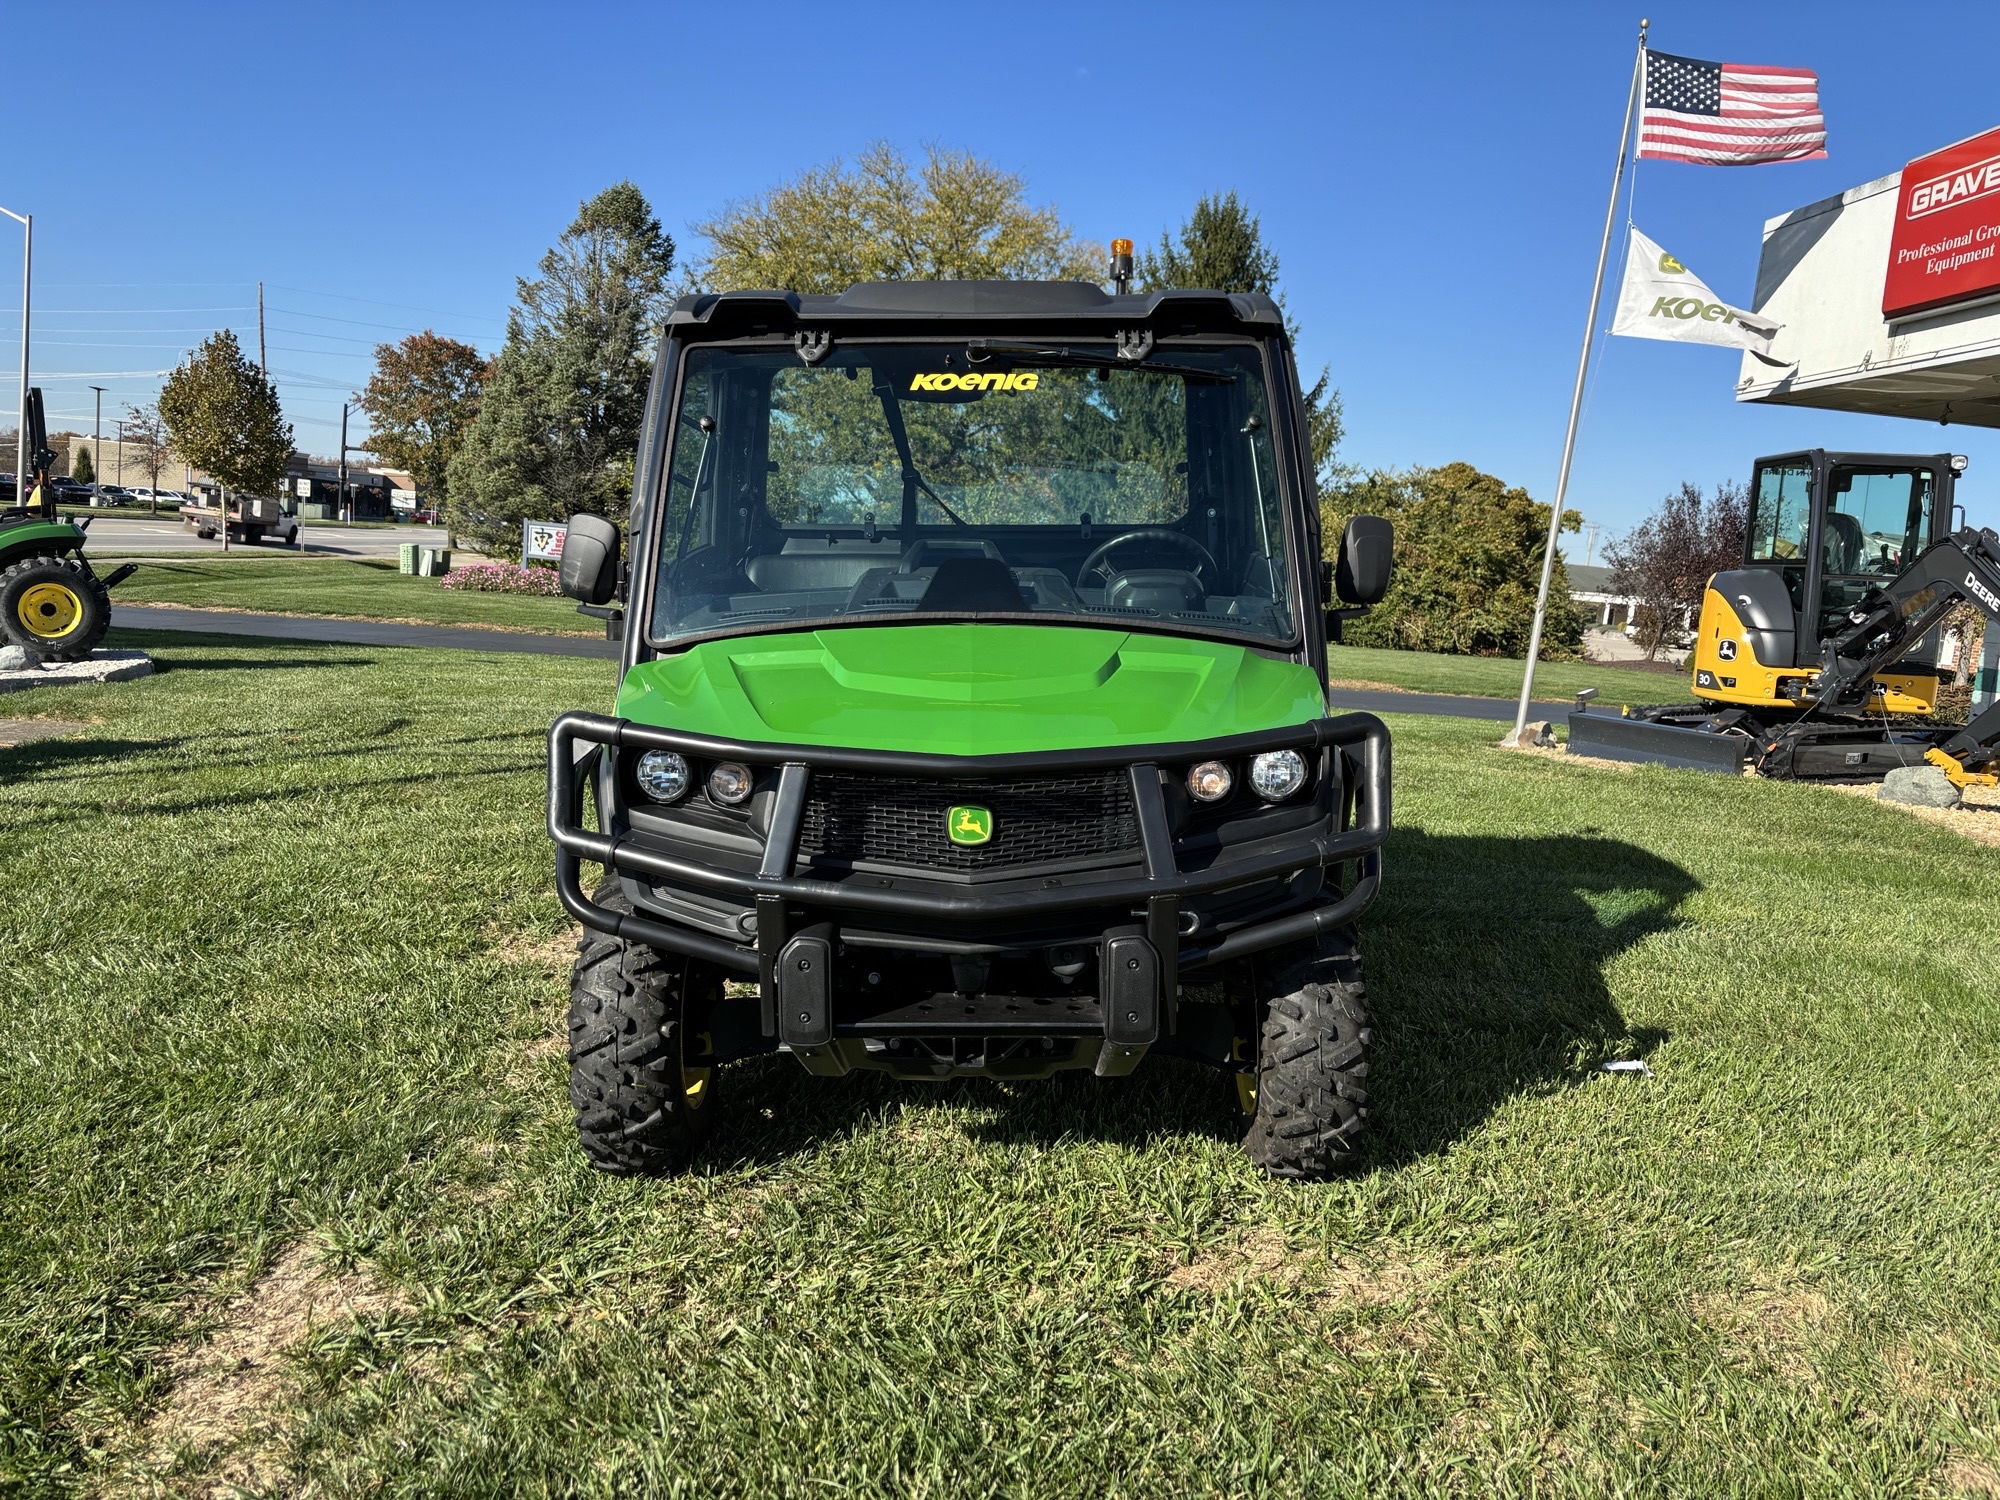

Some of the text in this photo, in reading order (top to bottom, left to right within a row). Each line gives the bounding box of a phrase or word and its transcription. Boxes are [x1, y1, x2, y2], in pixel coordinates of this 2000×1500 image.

[1911, 161, 2000, 213] GRAVE
[1897, 224, 2000, 264] Professional Gro
[1925, 243, 1995, 275] Equipment
[1964, 571, 2000, 612] DEERE
[1698, 673, 1735, 687] 30 P
